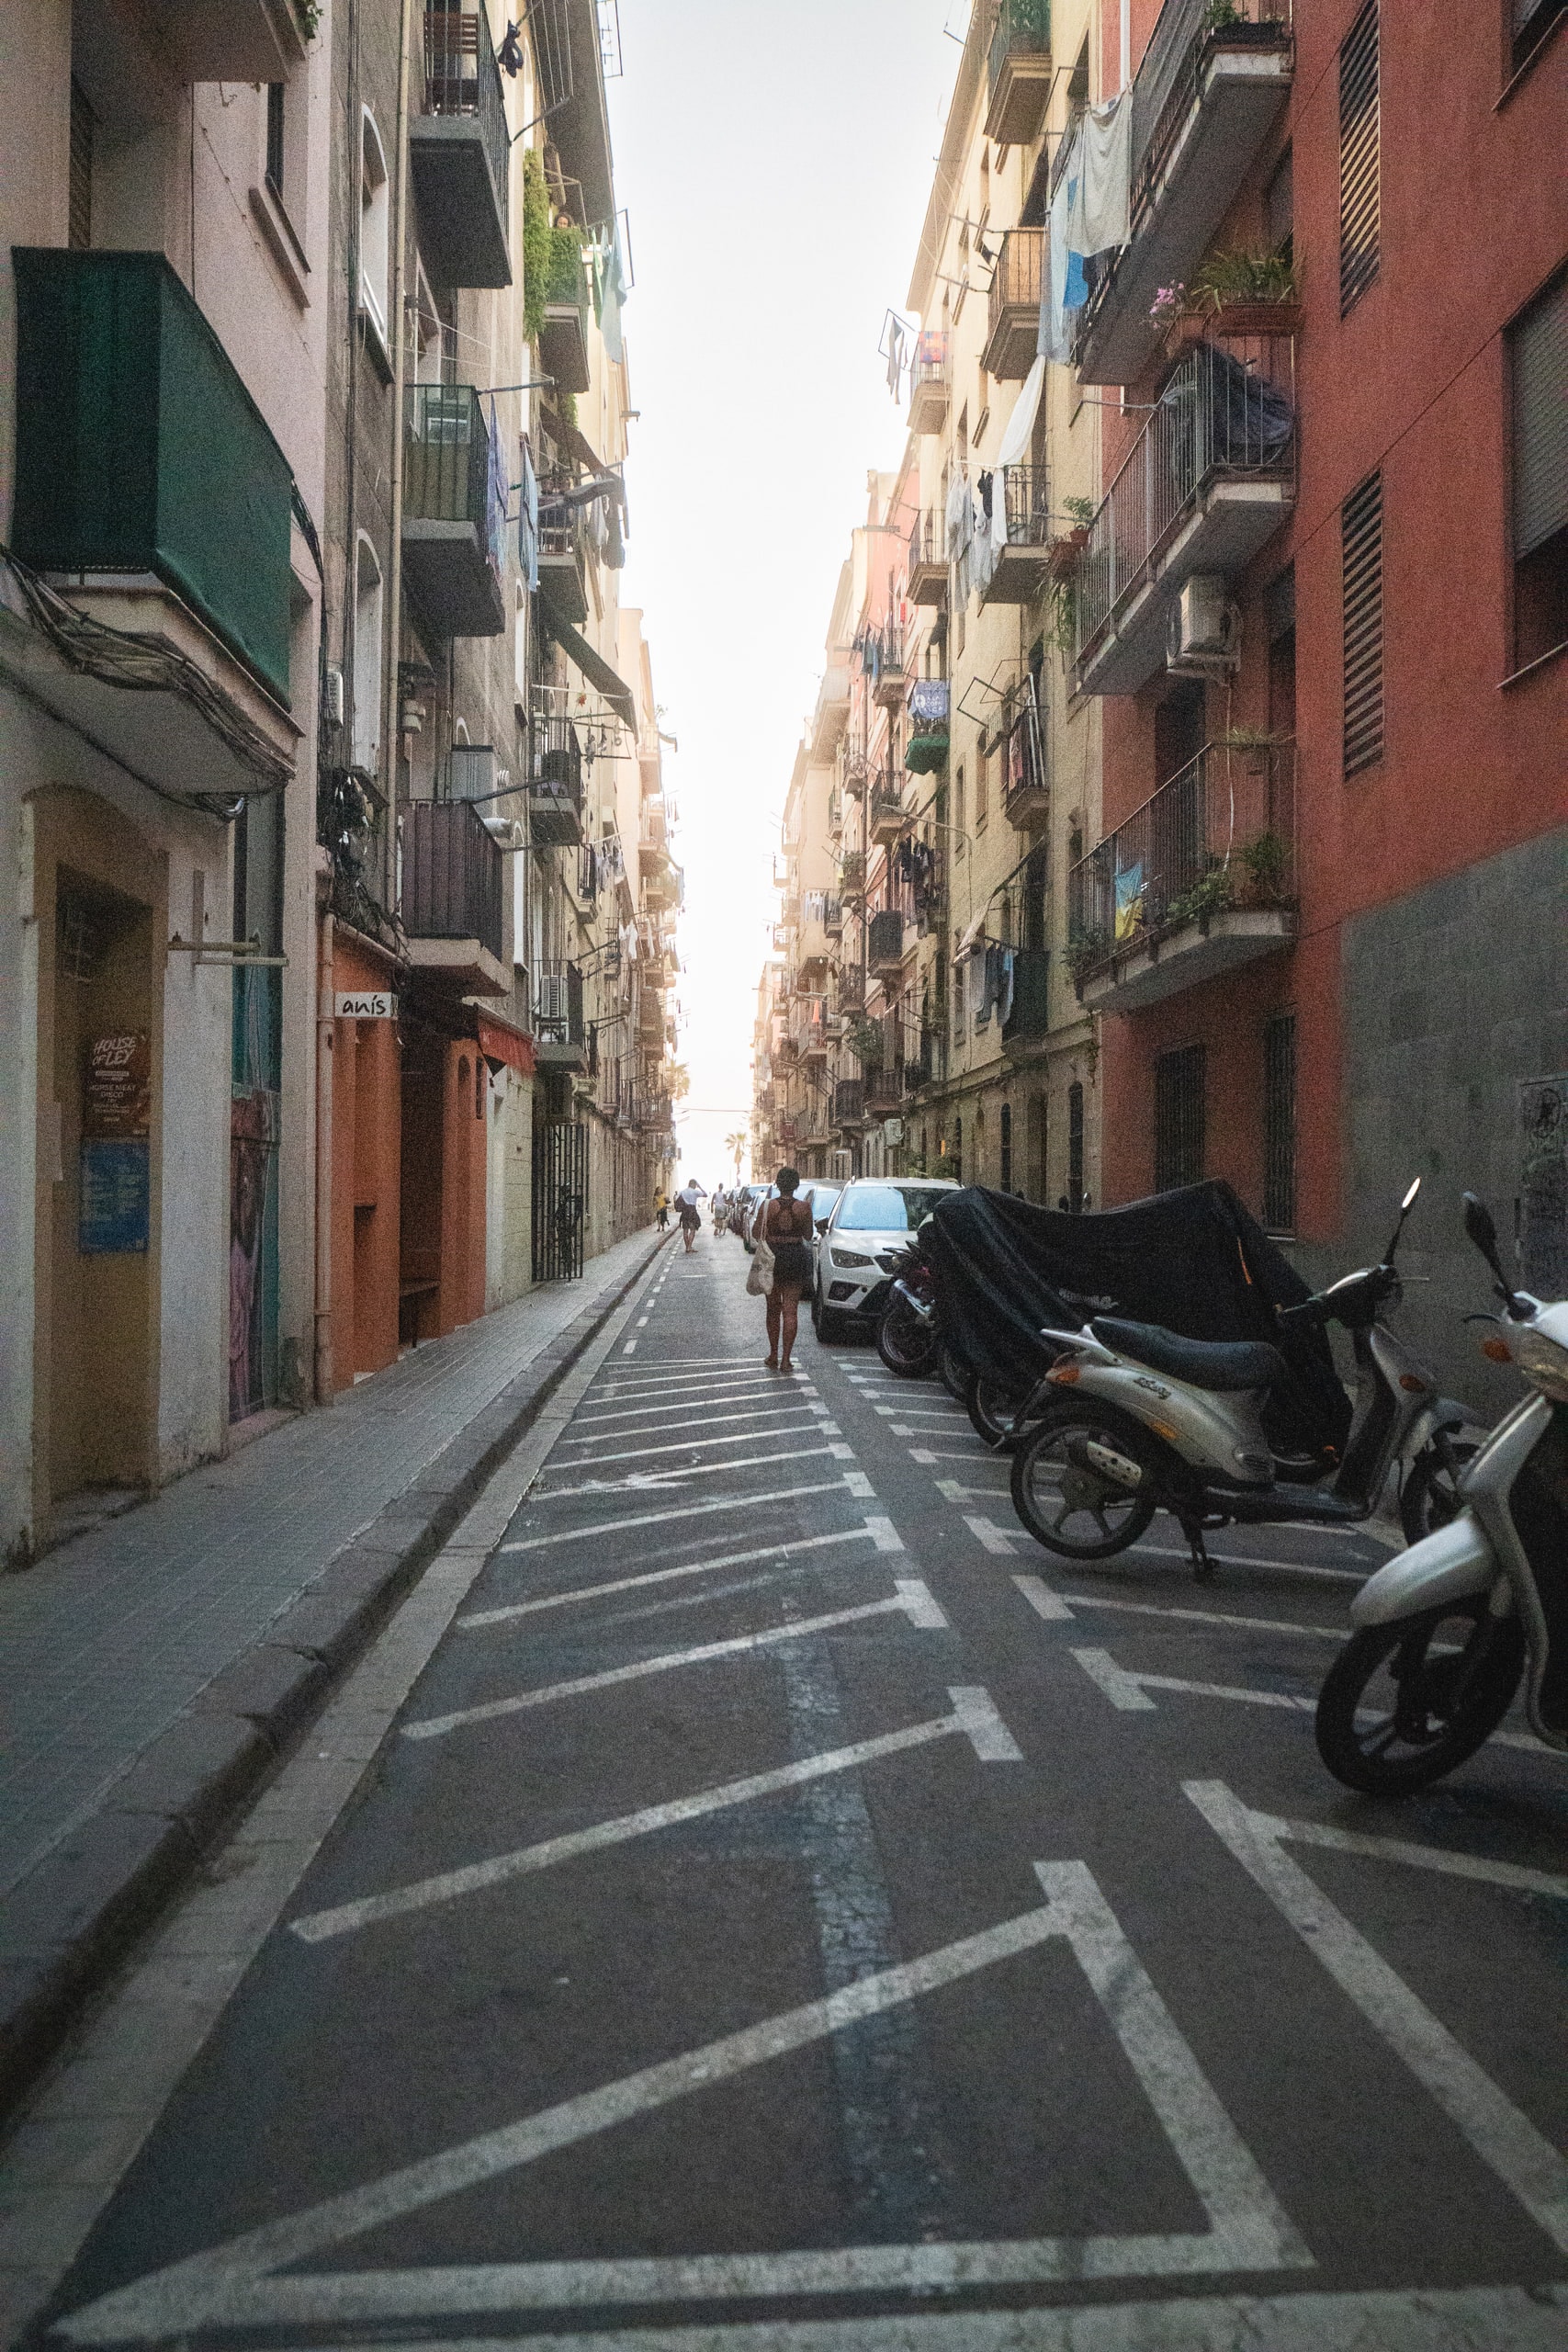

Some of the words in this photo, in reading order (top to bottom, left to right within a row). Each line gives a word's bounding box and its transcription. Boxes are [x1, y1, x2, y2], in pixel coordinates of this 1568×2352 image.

[343, 994, 386, 1014] anís
[94, 1036, 136, 1054] HOUSE
[92, 1054, 107, 1066] OF
[106, 1048, 135, 1066] LEY
